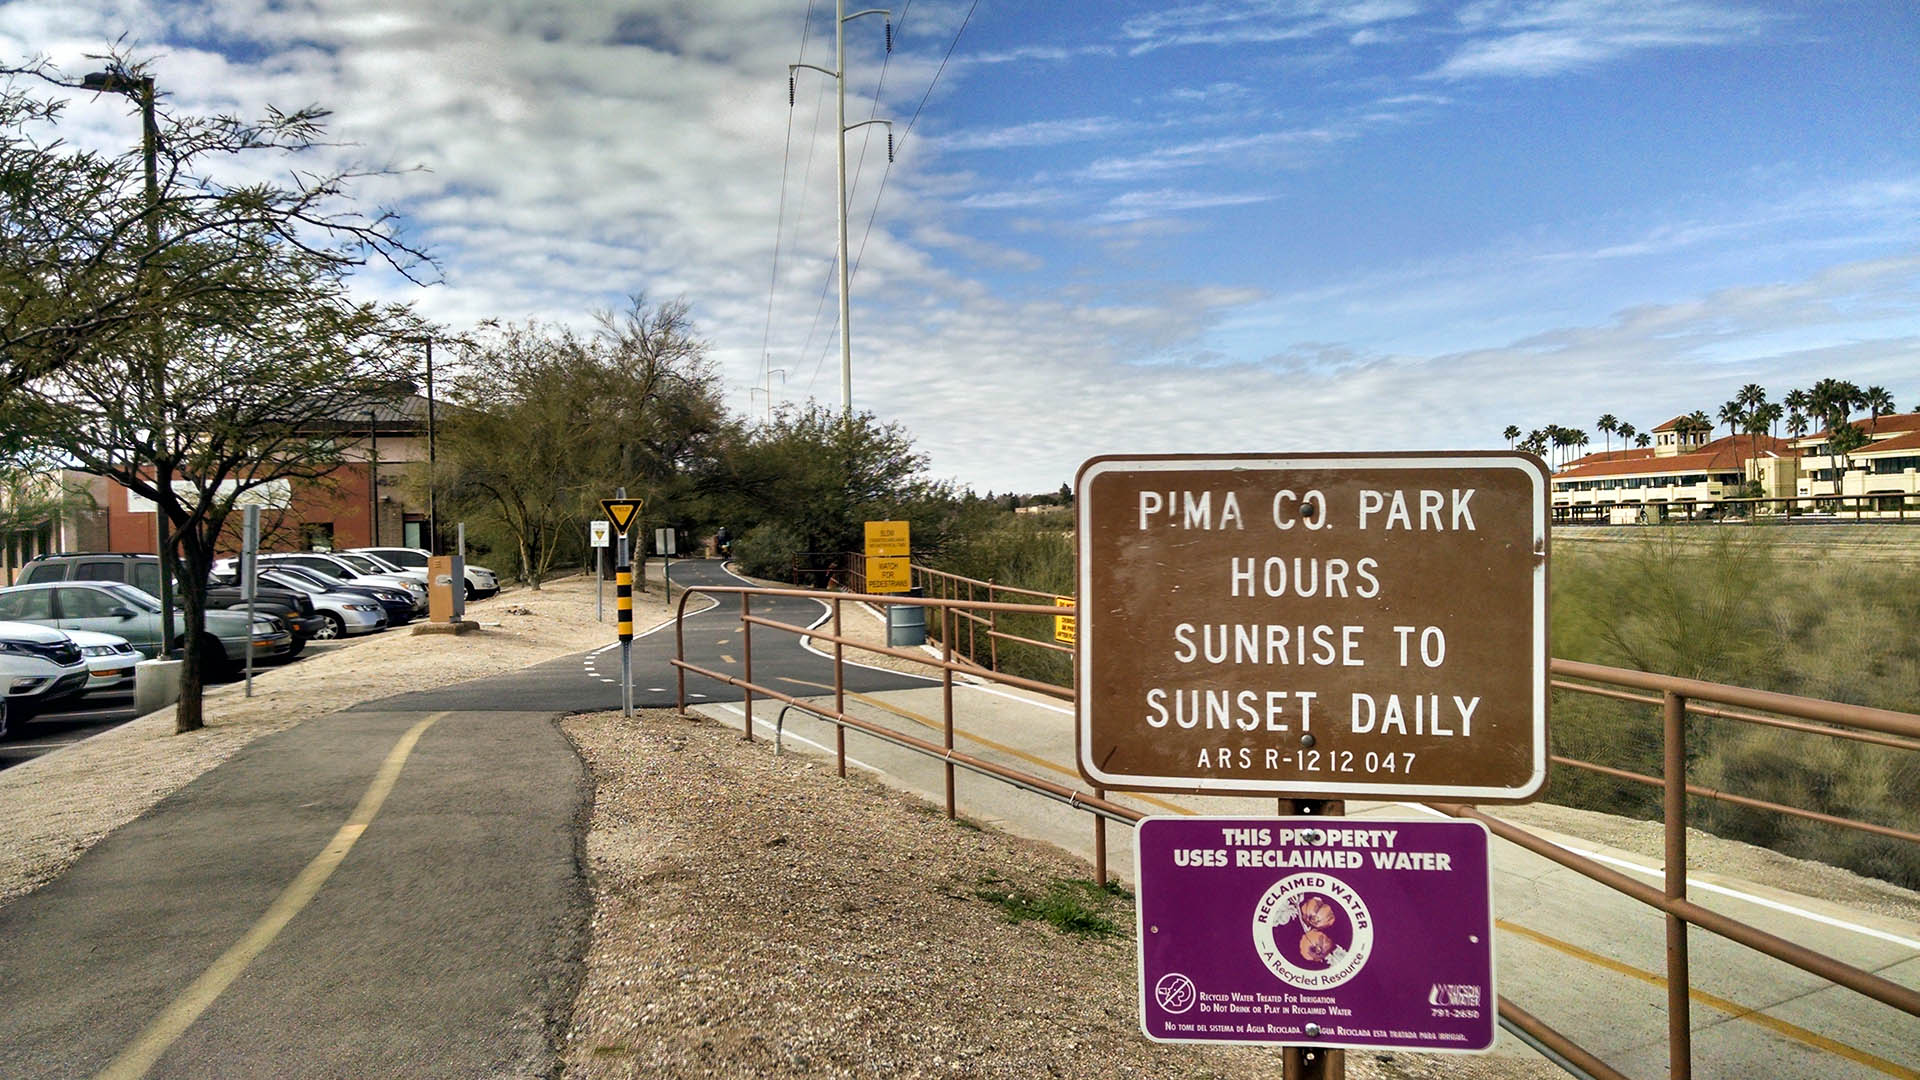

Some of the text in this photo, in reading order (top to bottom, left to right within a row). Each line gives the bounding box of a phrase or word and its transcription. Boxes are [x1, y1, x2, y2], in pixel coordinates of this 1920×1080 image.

[1138, 488, 1477, 531] PIMA CO. PARK
[1231, 557, 1381, 598] HOURS
[1174, 623, 1447, 667] SUNRISE TO
[1145, 688, 1481, 737] SUNSET DAILY
[1222, 829, 1398, 848] THIS PROPERTY
[1174, 849, 1452, 871] USES RECLAIMED WATER
[1258, 877, 1368, 929] RECLAIMED WATER
[1264, 951, 1364, 986] A Recycled Resource
